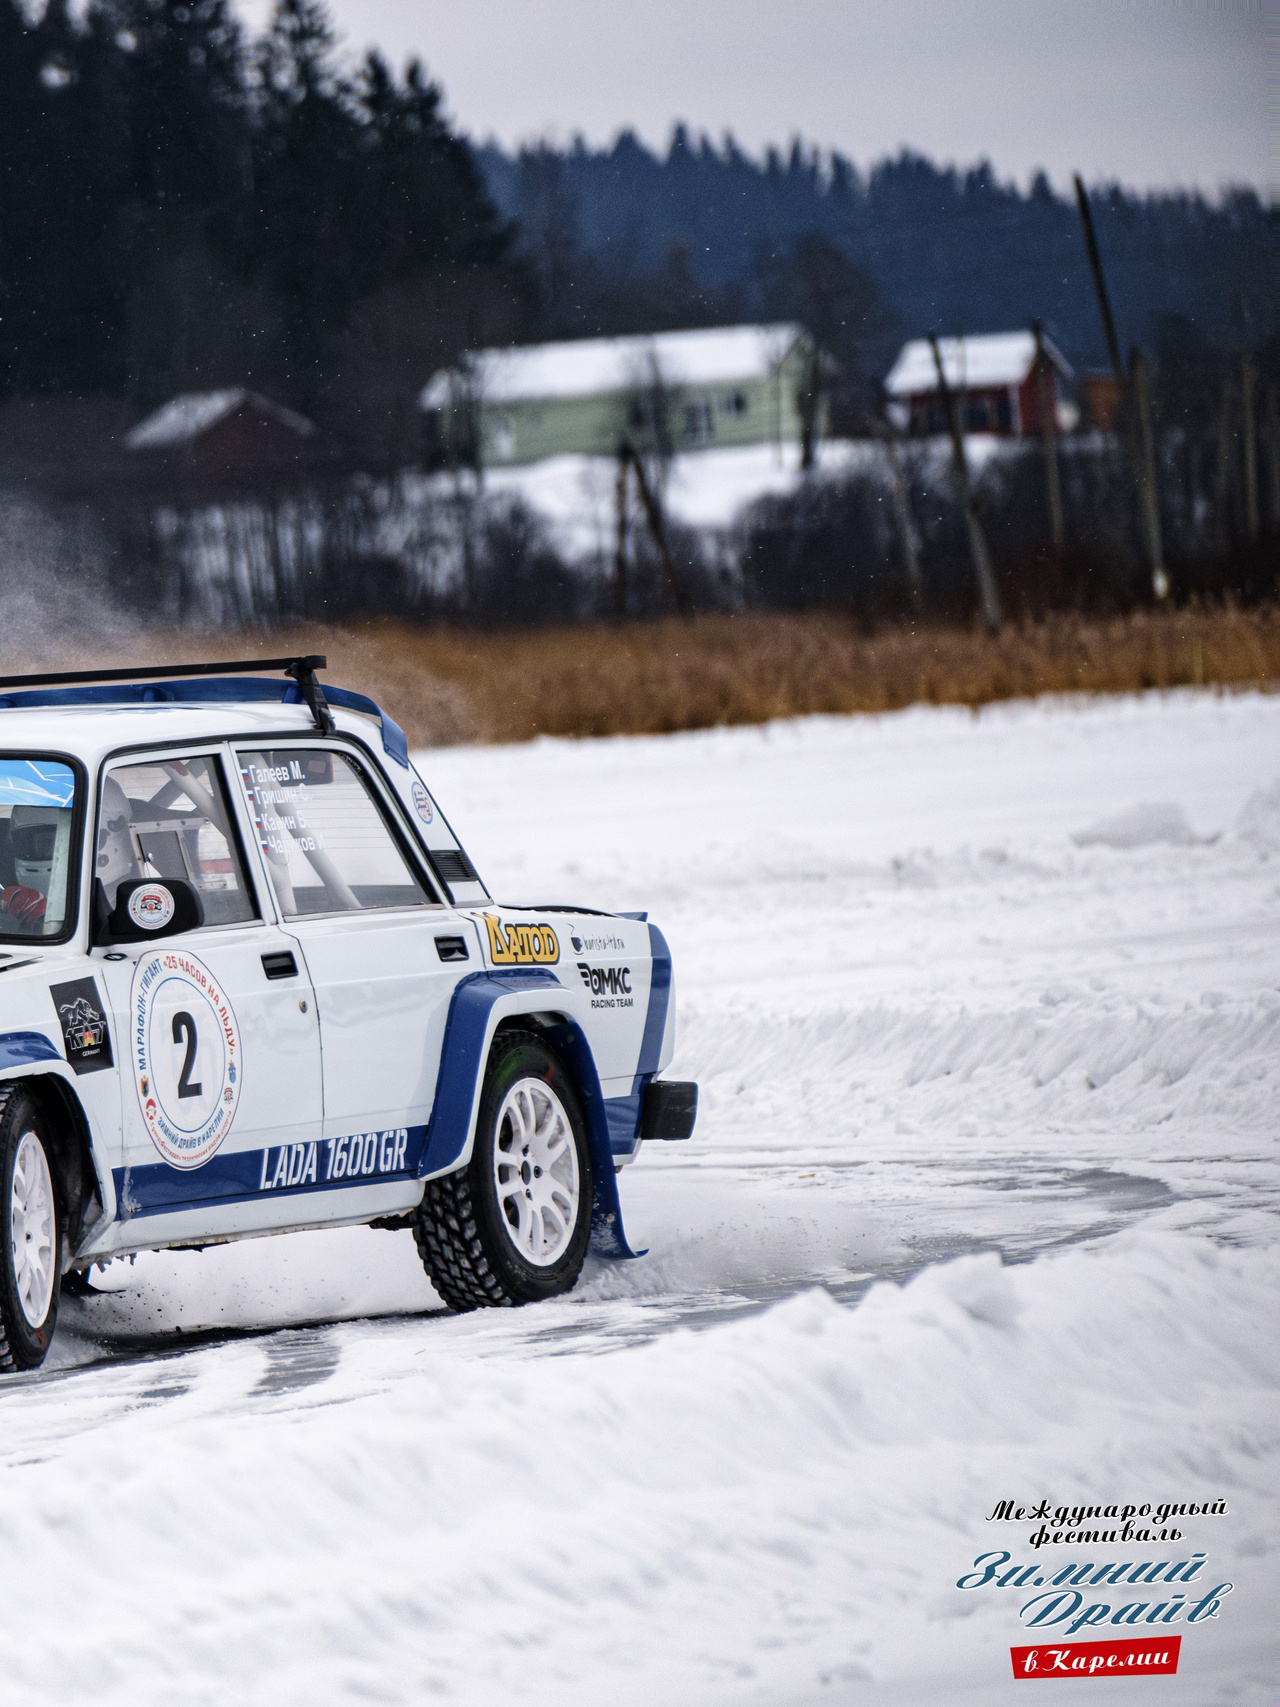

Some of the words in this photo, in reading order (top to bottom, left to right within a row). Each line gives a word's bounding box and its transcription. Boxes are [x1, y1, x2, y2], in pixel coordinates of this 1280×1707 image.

[248, 764, 290, 784] Галеев
[289, 760, 306, 780] М.
[136, 957, 163, 1071] МАРАФОН-ГИГАНТ
[178, 957, 207, 988] ЧАСОВ
[207, 984, 220, 1006] НА
[590, 999, 616, 1009] RACING
[616, 998, 634, 1008] TEAM
[171, 1010, 203, 1100] 2
[157, 1116, 179, 1147] ЗИМНИЙ
[177, 1136, 197, 1150] ДРАЙВ
[197, 1136, 202, 1147] В
[202, 1107, 225, 1144] КАРЕЛИИ
[260, 1141, 318, 1190] LADA
